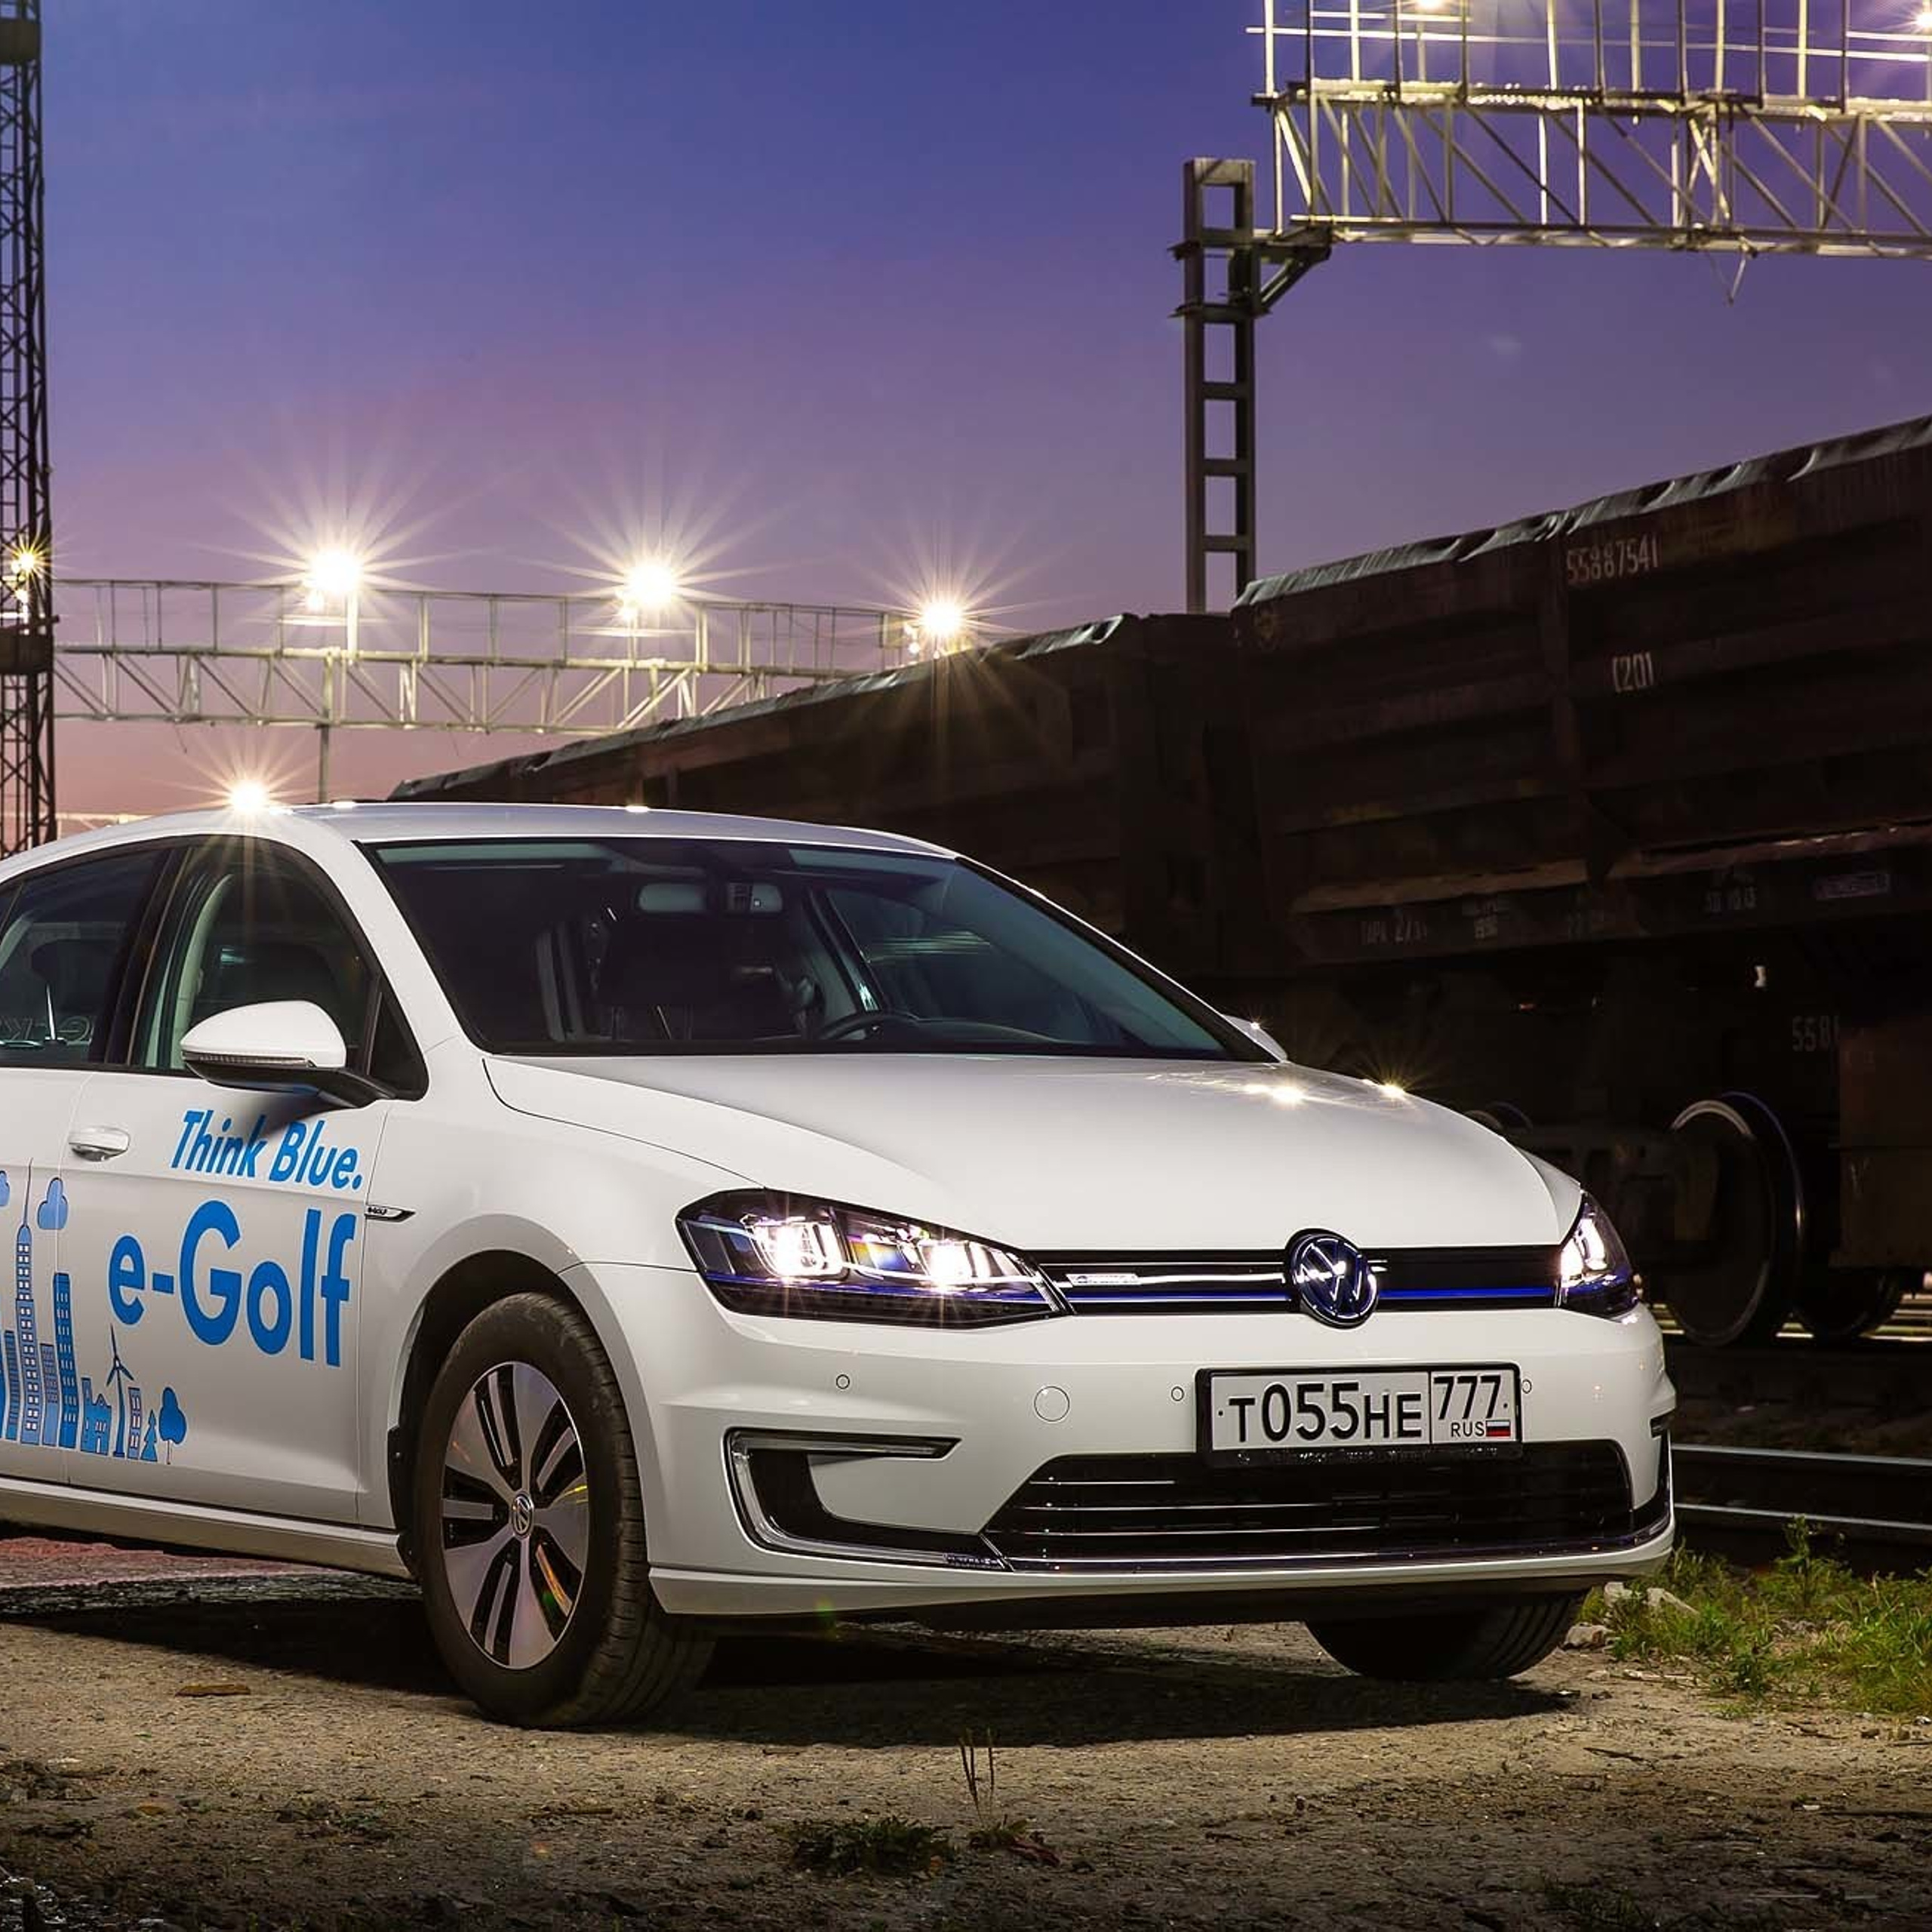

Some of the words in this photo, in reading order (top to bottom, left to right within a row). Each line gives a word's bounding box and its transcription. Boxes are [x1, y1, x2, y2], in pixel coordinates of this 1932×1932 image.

[1567, 534, 1658, 580] 55887541
[171, 1109, 268, 1177] Think
[269, 1120, 363, 1189] Blue.
[108, 1199, 357, 1367] e-Golf
[1433, 1374, 1502, 1420] 777
[1451, 1422, 1485, 1438] RUS
